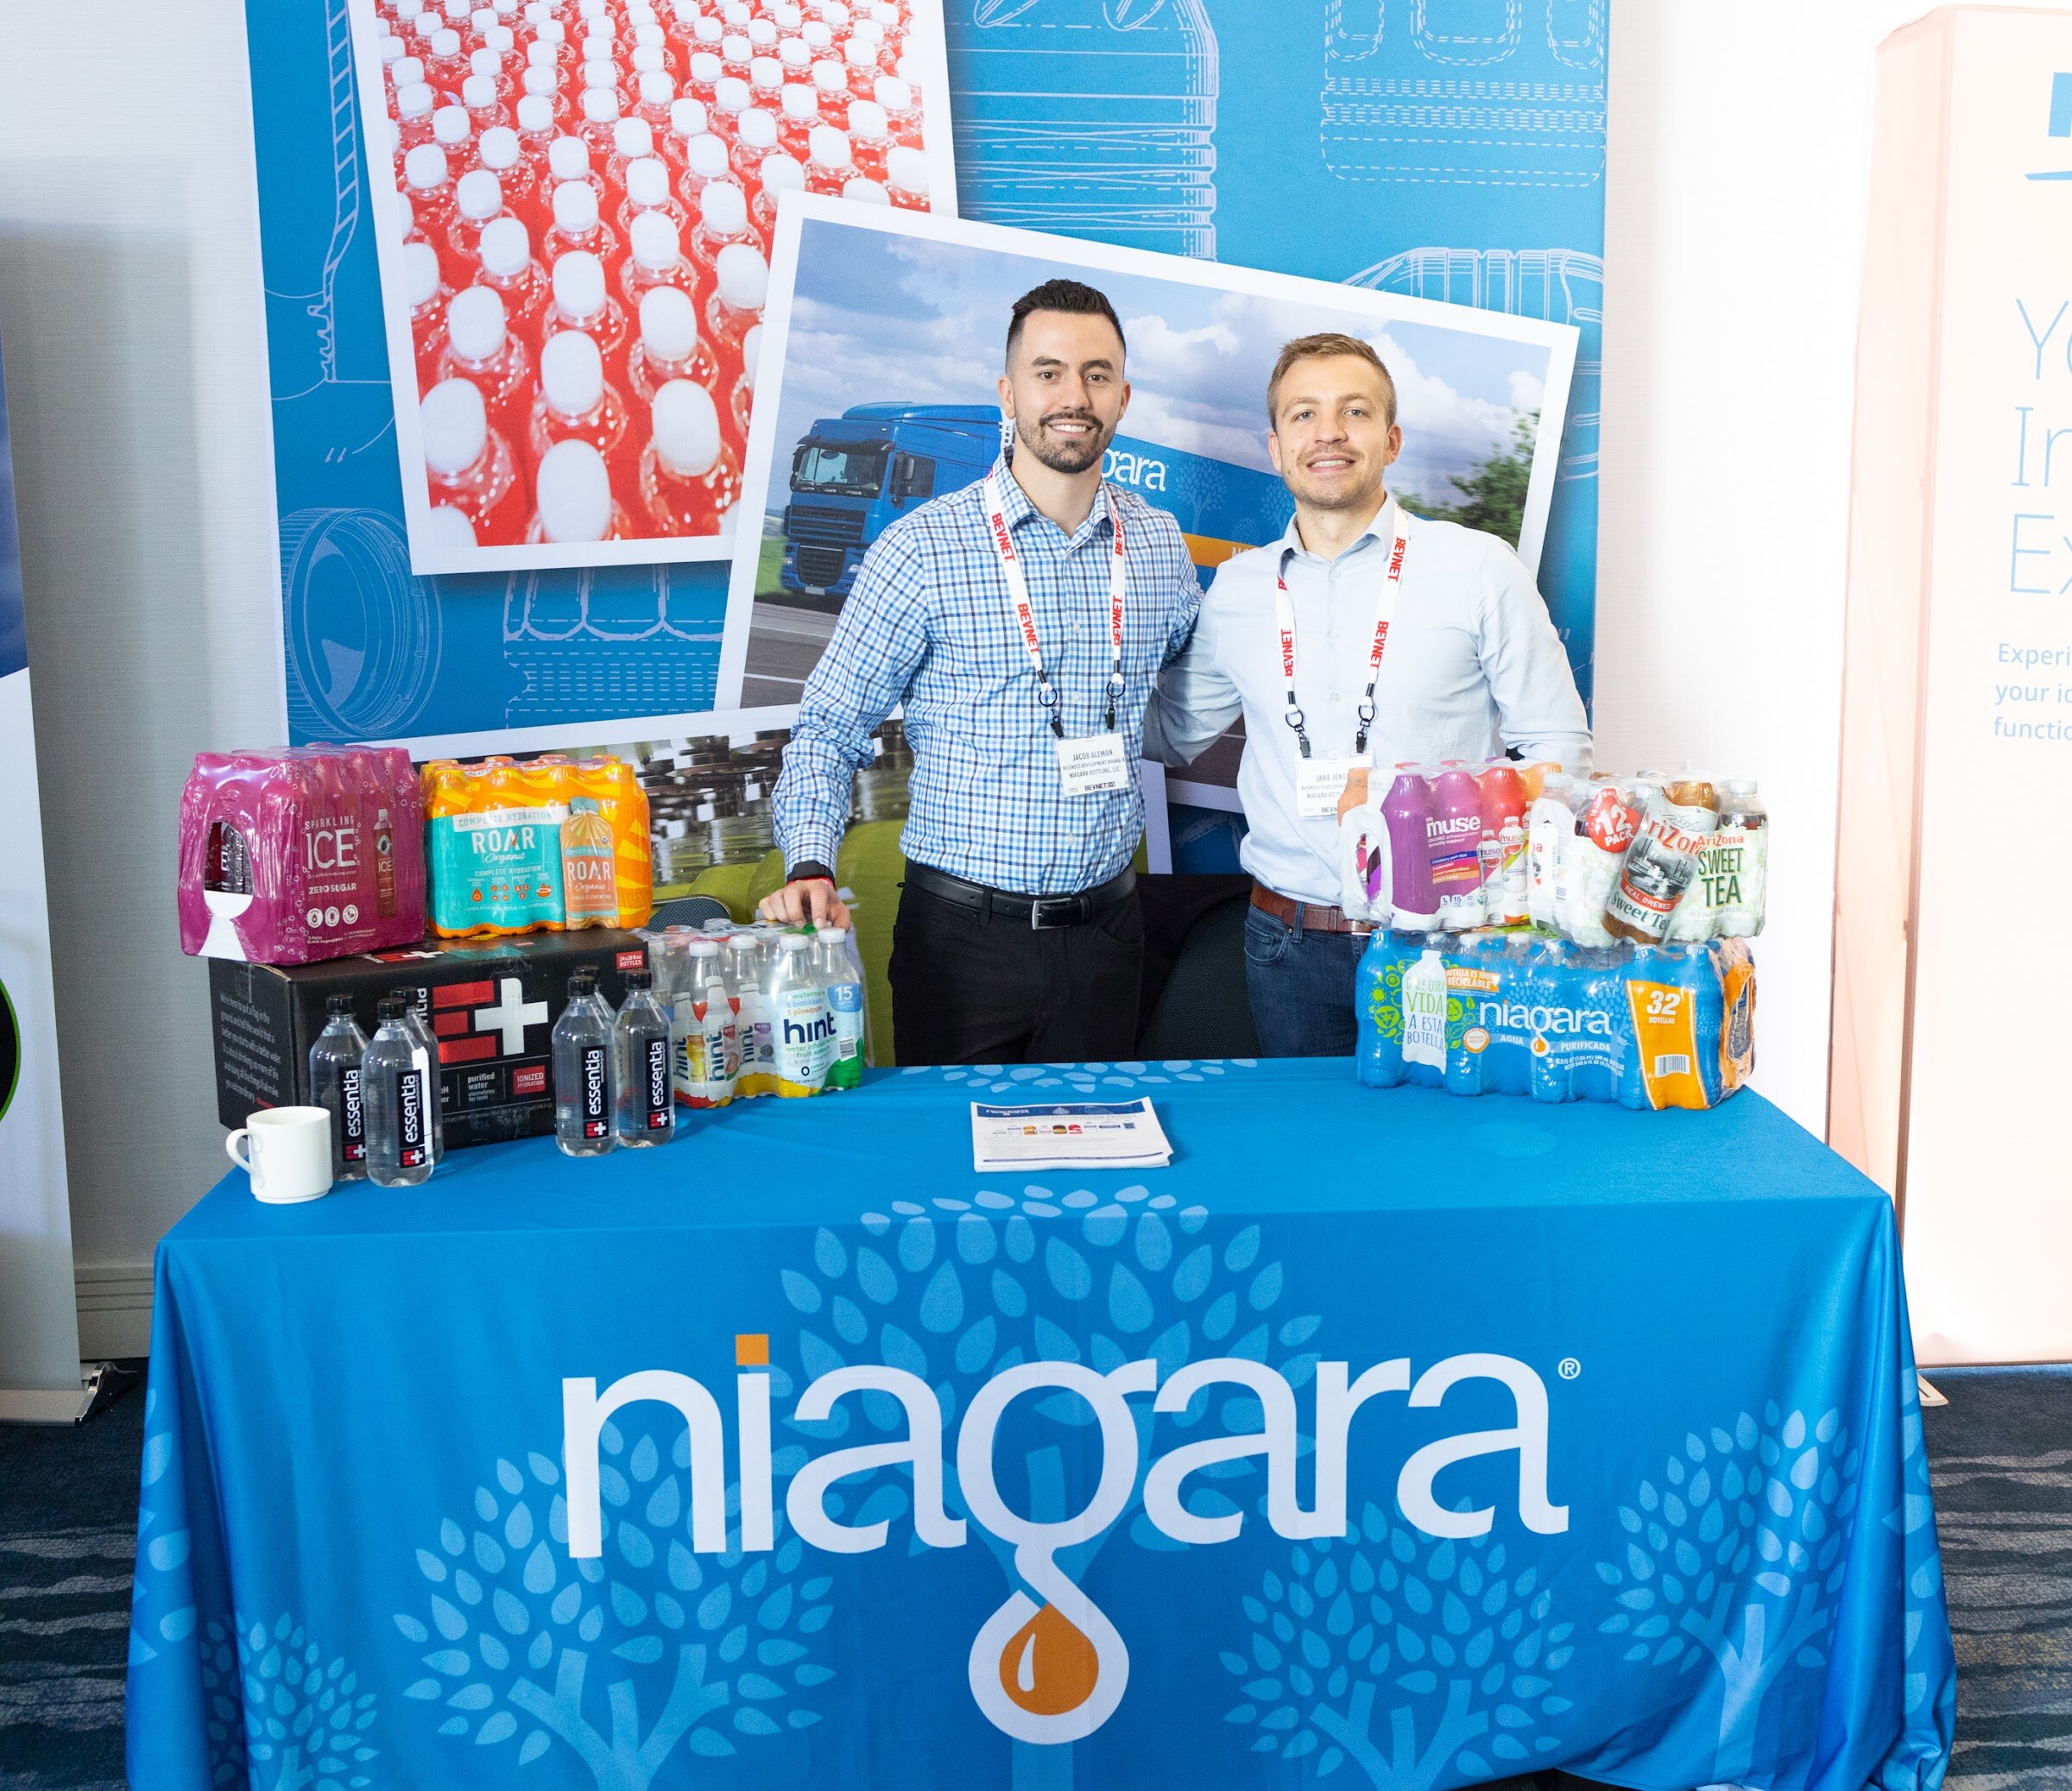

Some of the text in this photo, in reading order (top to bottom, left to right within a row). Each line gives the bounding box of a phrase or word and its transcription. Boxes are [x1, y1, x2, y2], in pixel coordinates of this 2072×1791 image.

[2016, 299, 2072, 380] Y
[991, 512, 1015, 562] BEVNET
[1388, 537, 1406, 583] BEVNET
[1018, 602, 1039, 654] BEVNET
[1111, 596, 1122, 646] BEVNET
[1280, 628, 1293, 678] BEVNET
[1369, 621, 1389, 670] BEVNET
[1994, 683, 2050, 706] your
[1073, 749, 1113, 761] JACOB ALEMAN
[1069, 770, 1089, 779] NIAGARA
[1084, 782, 1107, 791] BEVNET
[1316, 773, 1330, 782] JAKE
[305, 815, 355, 830] SPARKLING
[506, 810, 553, 822] HYDRATION
[1425, 816, 1481, 837] muse
[1596, 804, 1633, 836] 12
[306, 828, 357, 871] ICE
[471, 826, 535, 855] ROAR
[1604, 829, 1635, 847] PACK
[484, 853, 526, 864] Organic
[1698, 847, 1744, 875] SWEET
[566, 861, 612, 882] ROAR
[308, 882, 357, 895] ZERO SUGAR
[575, 882, 606, 893] Organic
[1624, 886, 1672, 910] REAL BREWED
[1701, 874, 1741, 907] TEA
[1612, 890, 1649, 922] Sweet
[619, 959, 642, 968] BOTTLES
[835, 986, 853, 1002] 15
[1447, 976, 1492, 990] RECICLABLE
[1406, 992, 1443, 1018] VIDA
[1646, 990, 1681, 1016] 32
[783, 1012, 837, 1044] hint
[1409, 1014, 1443, 1036] A ESTA
[1479, 999, 1613, 1057] niagara
[1648, 1016, 1676, 1025] BOTELLAS
[738, 1025, 755, 1065] hint
[1407, 1031, 1444, 1055] BOTELLA
[1500, 1035, 1612, 1052] AGUA PURIFICADA
[672, 1037, 689, 1081] hint
[706, 1031, 725, 1082] hint
[467, 1071, 496, 1084] purified
[517, 1072, 544, 1082] IONIZED
[517, 1080, 545, 1088] HYDRATION
[585, 1049, 602, 1115] essentia
[649, 1041, 663, 1107] essentia
[468, 1082, 489, 1091] water
[343, 1069, 362, 1138] essentia
[401, 1074, 418, 1143] essentia
